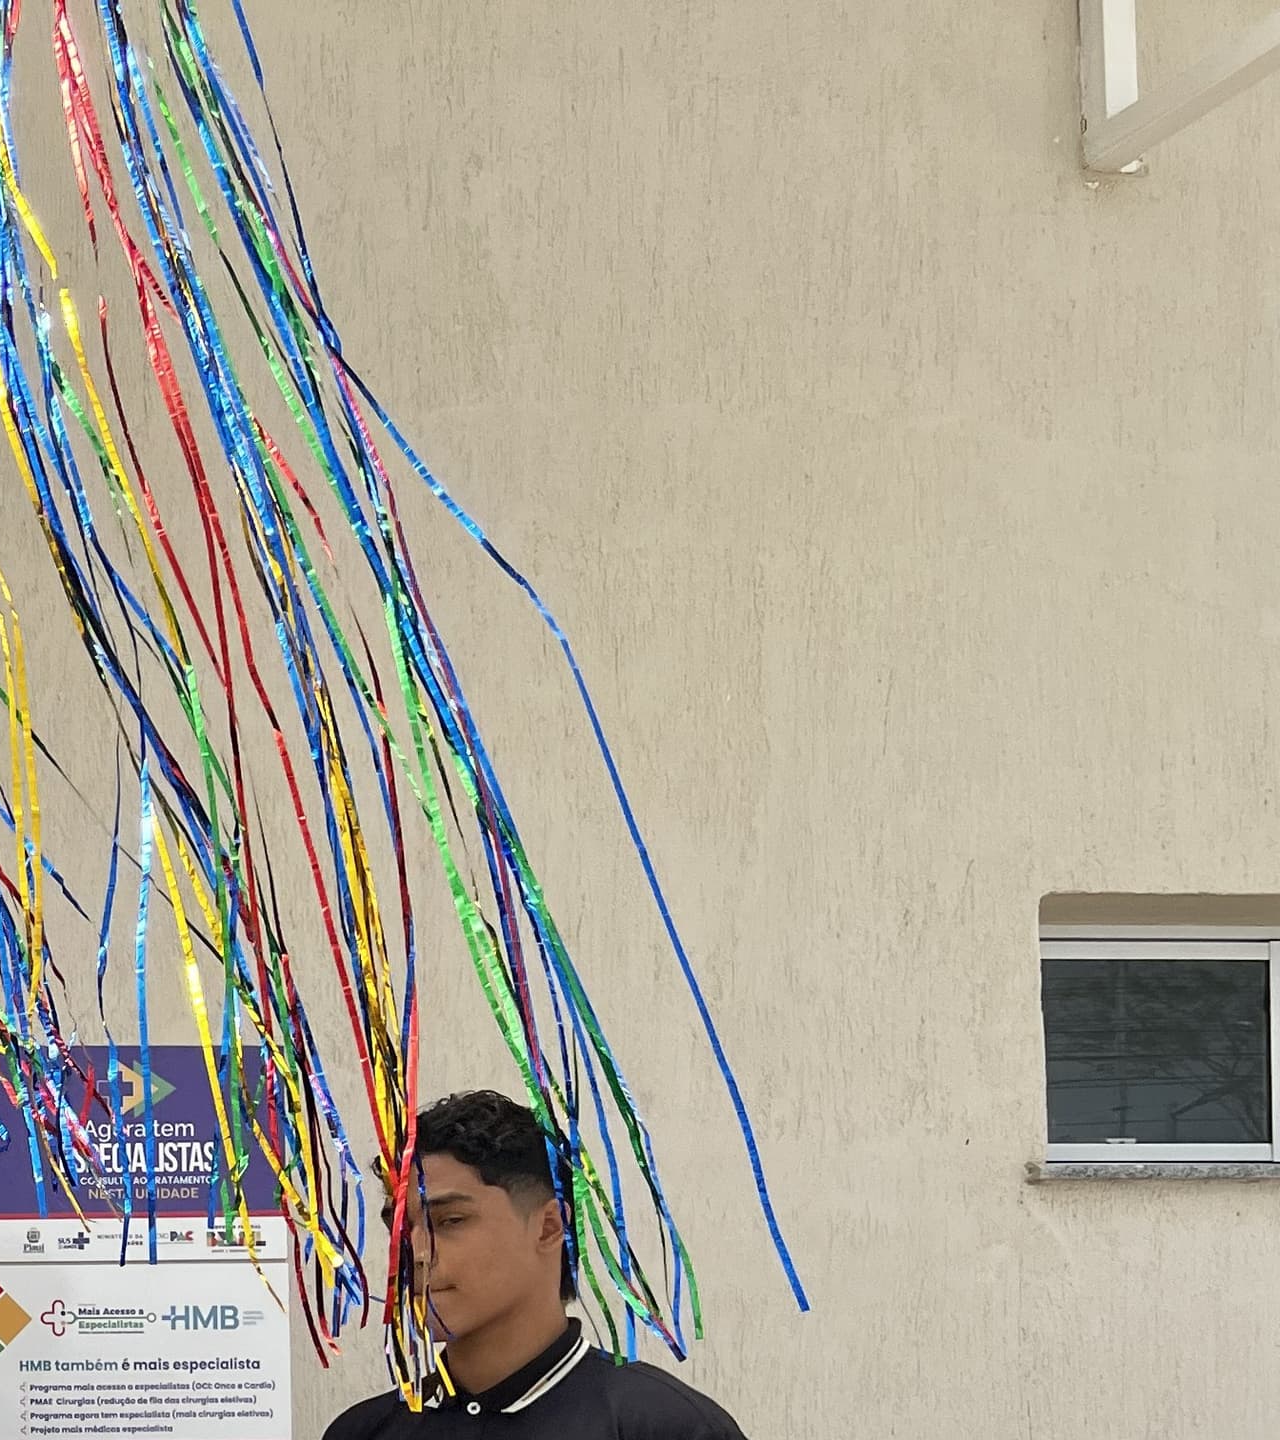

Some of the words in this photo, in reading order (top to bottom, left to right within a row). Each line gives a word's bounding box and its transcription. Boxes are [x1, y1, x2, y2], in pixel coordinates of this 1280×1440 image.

[84, 1119, 145, 1142] Agra
[153, 1119, 195, 1137] tem
[170, 1231, 193, 1241] PAC
[78, 1307, 100, 1316] Mais
[102, 1307, 137, 1316] Acesso
[170, 1305, 240, 1330] HMB
[78, 1320, 144, 1331] Especialistas
[19, 1360, 52, 1372] HMB
[55, 1358, 118, 1371] também
[121, 1358, 131, 1371] é
[133, 1358, 170, 1370] mais
[172, 1357, 261, 1374] especialista
[30, 1384, 72, 1393] Programa
[73, 1383, 95, 1391] mais
[135, 1382, 190, 1392] especialistas
[55, 1397, 95, 1407] Cirurgias
[96, 1396, 136, 1407] (redução
[137, 1396, 148, 1405] de
[164, 1396, 180, 1404] das
[181, 1395, 219, 1405] cirurgias
[220, 1395, 257, 1405] eletivas)
[30, 1412, 73, 1421] Programa
[74, 1413, 99, 1421] agora
[119, 1411, 171, 1420] especialista
[172, 1409, 197, 1419] (mais
[198, 1409, 235, 1419] cirurgias
[237, 1408, 274, 1418] eletivas)
[30, 1426, 60, 1435] Projeto
[62, 1425, 83, 1434] mais
[122, 1424, 173, 1434] especialista
